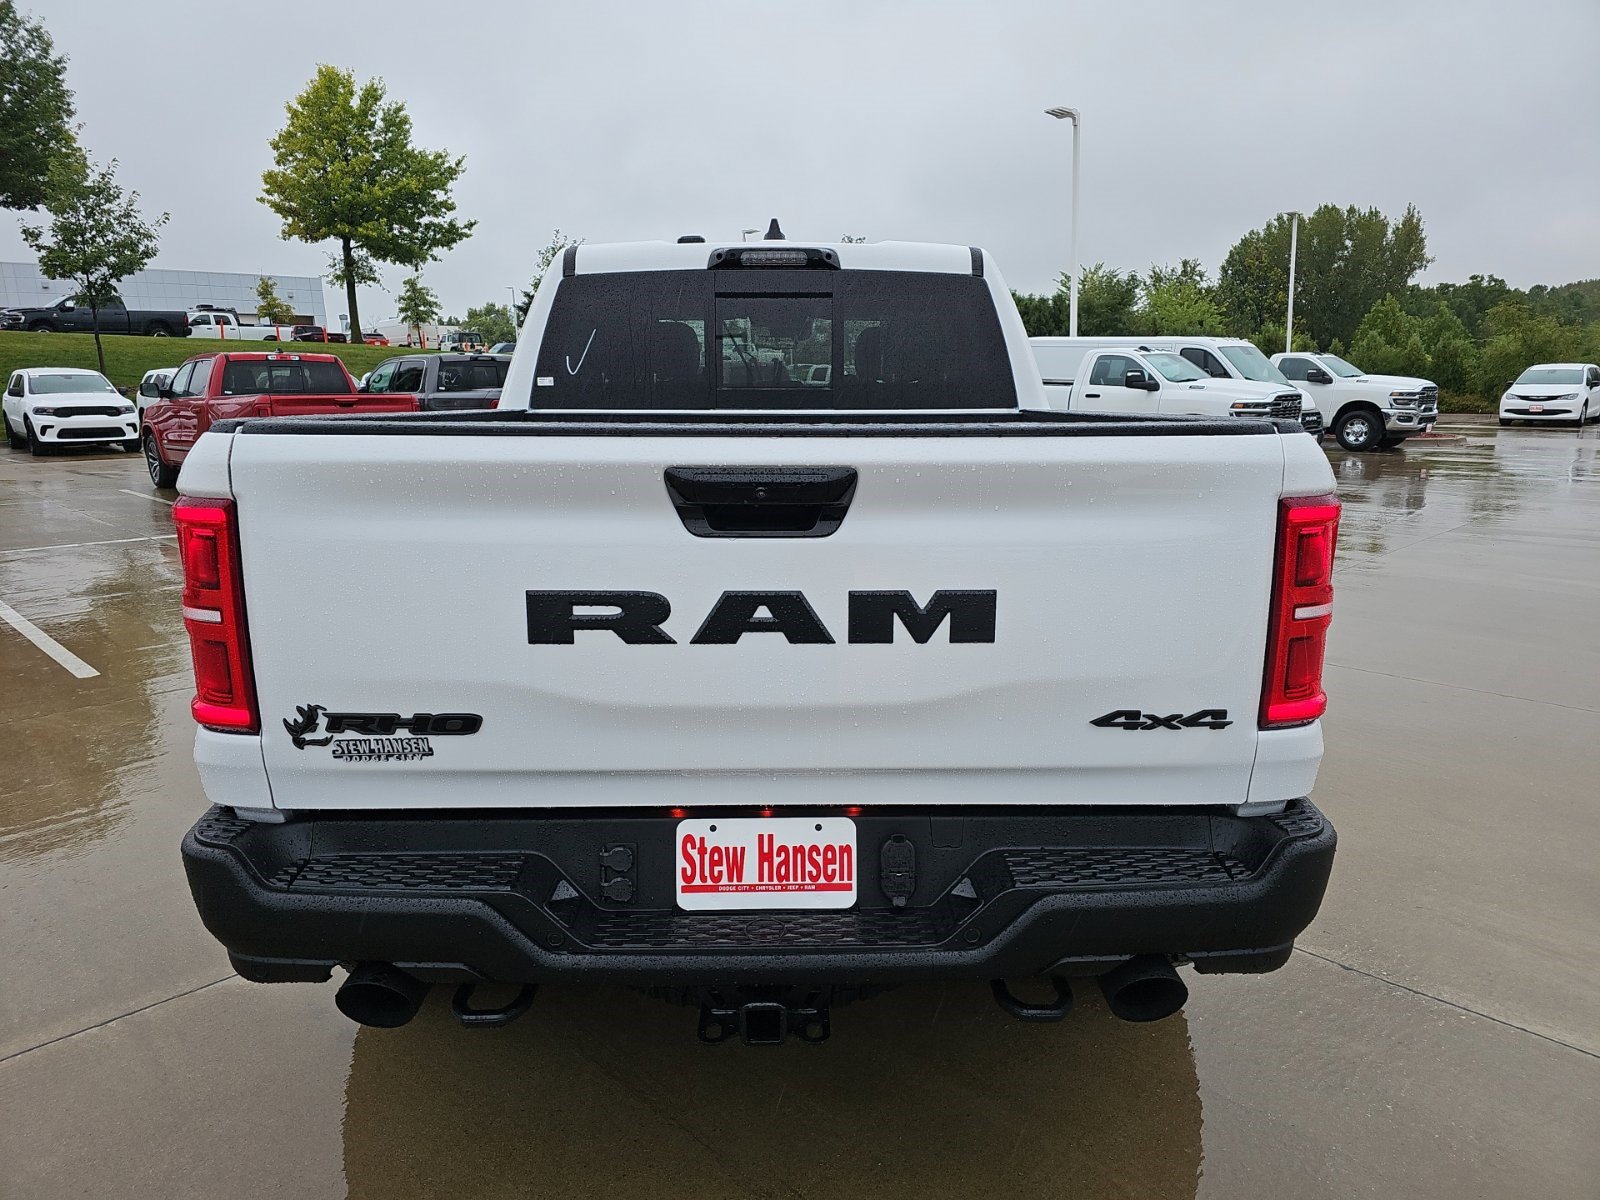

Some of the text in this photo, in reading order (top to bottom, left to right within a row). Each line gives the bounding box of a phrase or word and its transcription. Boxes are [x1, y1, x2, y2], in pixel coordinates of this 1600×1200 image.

[526, 589, 997, 645] RAM
[322, 712, 484, 736] RHO
[1089, 709, 1234, 731] 4x4
[332, 737, 431, 755] STEW HANSEN
[343, 753, 423, 762] DODGE CITY
[681, 833, 853, 885] Stew Hansen
